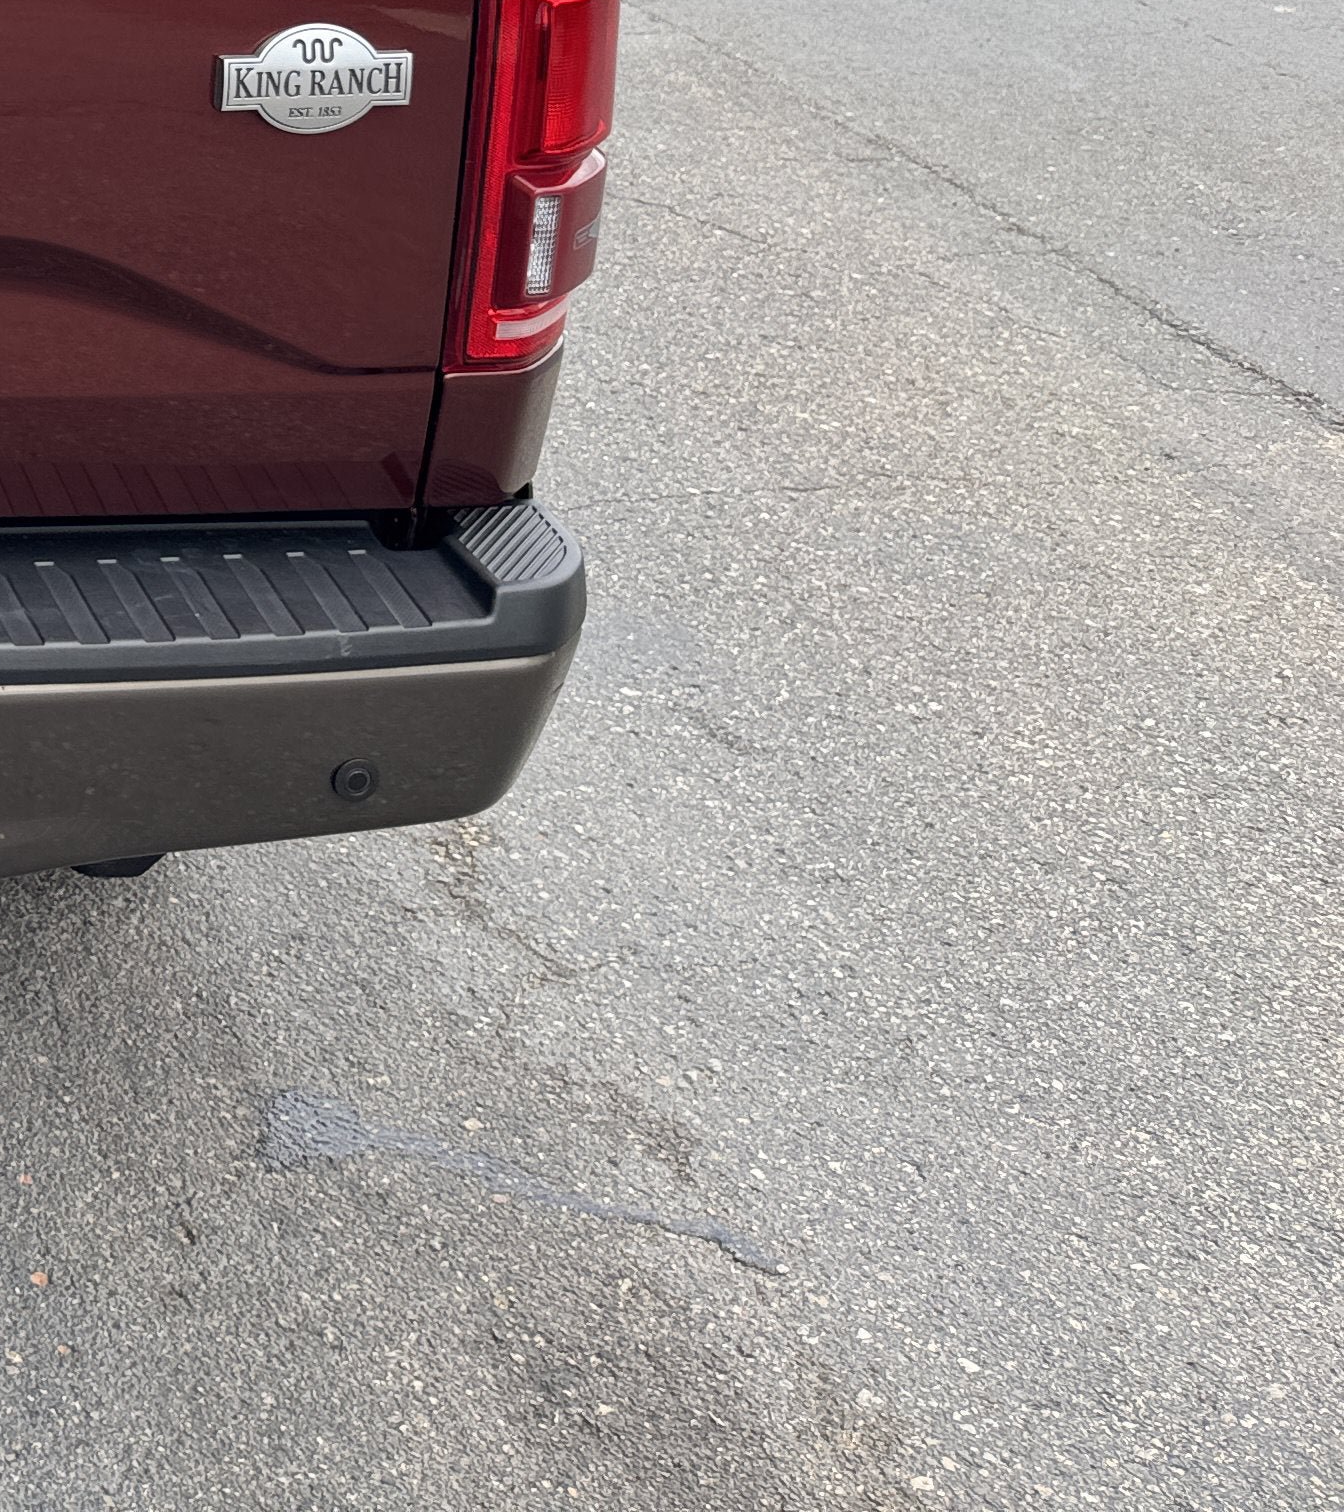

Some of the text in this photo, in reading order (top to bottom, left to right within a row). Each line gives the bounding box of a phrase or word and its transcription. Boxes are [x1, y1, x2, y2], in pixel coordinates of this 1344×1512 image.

[233, 62, 403, 99] KING RANCH
[318, 106, 342, 118] 1853
